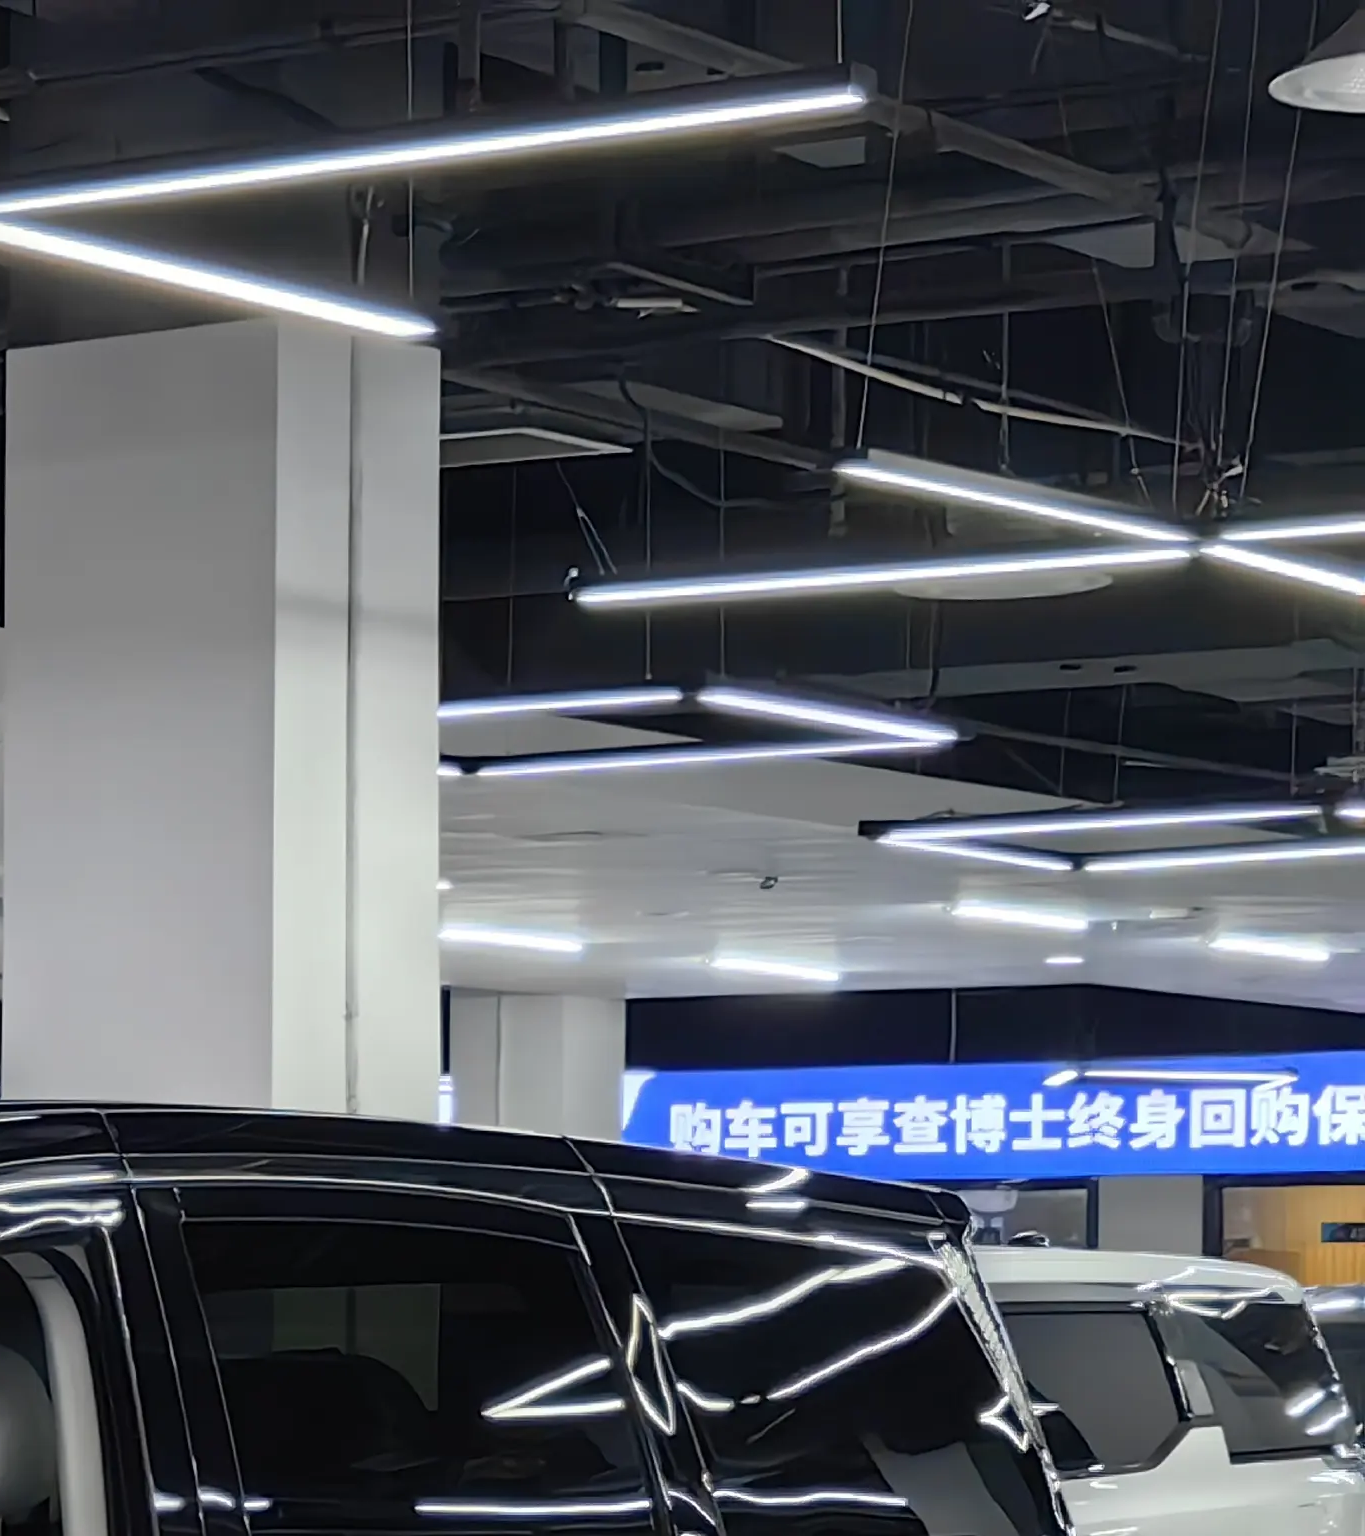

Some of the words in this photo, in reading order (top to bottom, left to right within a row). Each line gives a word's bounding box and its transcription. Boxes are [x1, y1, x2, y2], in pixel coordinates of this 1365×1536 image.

[669, 1084, 1365, 1159] 购车可享查博士终身回购保
